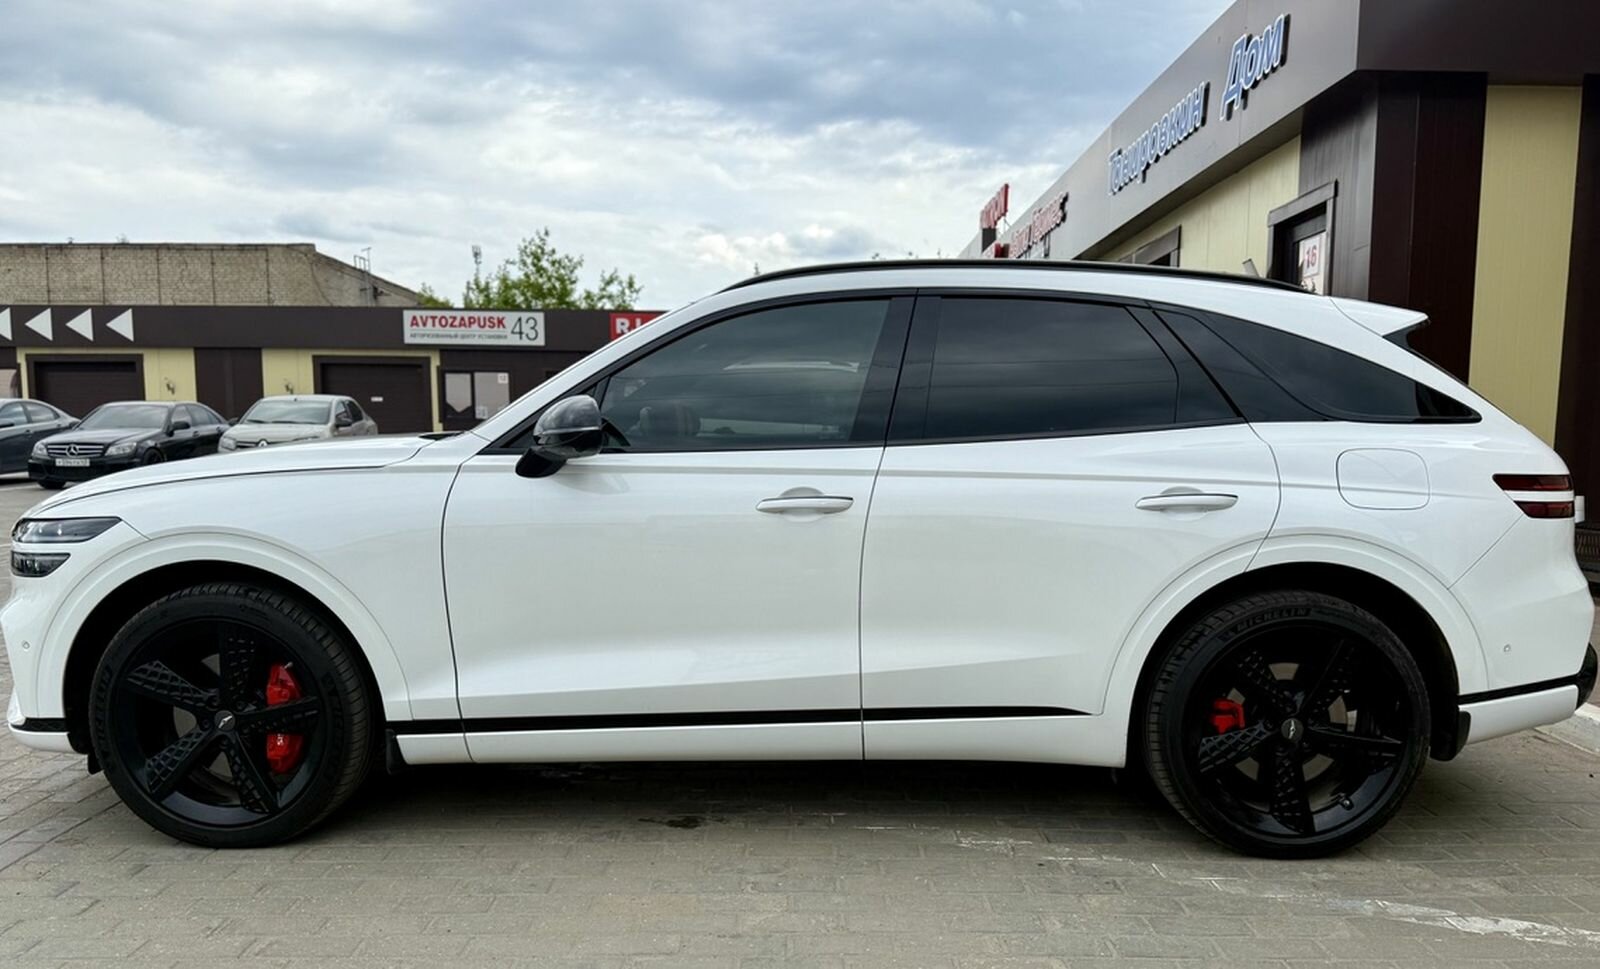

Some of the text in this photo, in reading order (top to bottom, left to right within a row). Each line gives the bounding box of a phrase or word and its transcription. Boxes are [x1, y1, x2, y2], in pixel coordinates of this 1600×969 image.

[1219, 13, 1288, 121] Дом
[410, 315, 539, 341] AVTOZAPUSK 43
